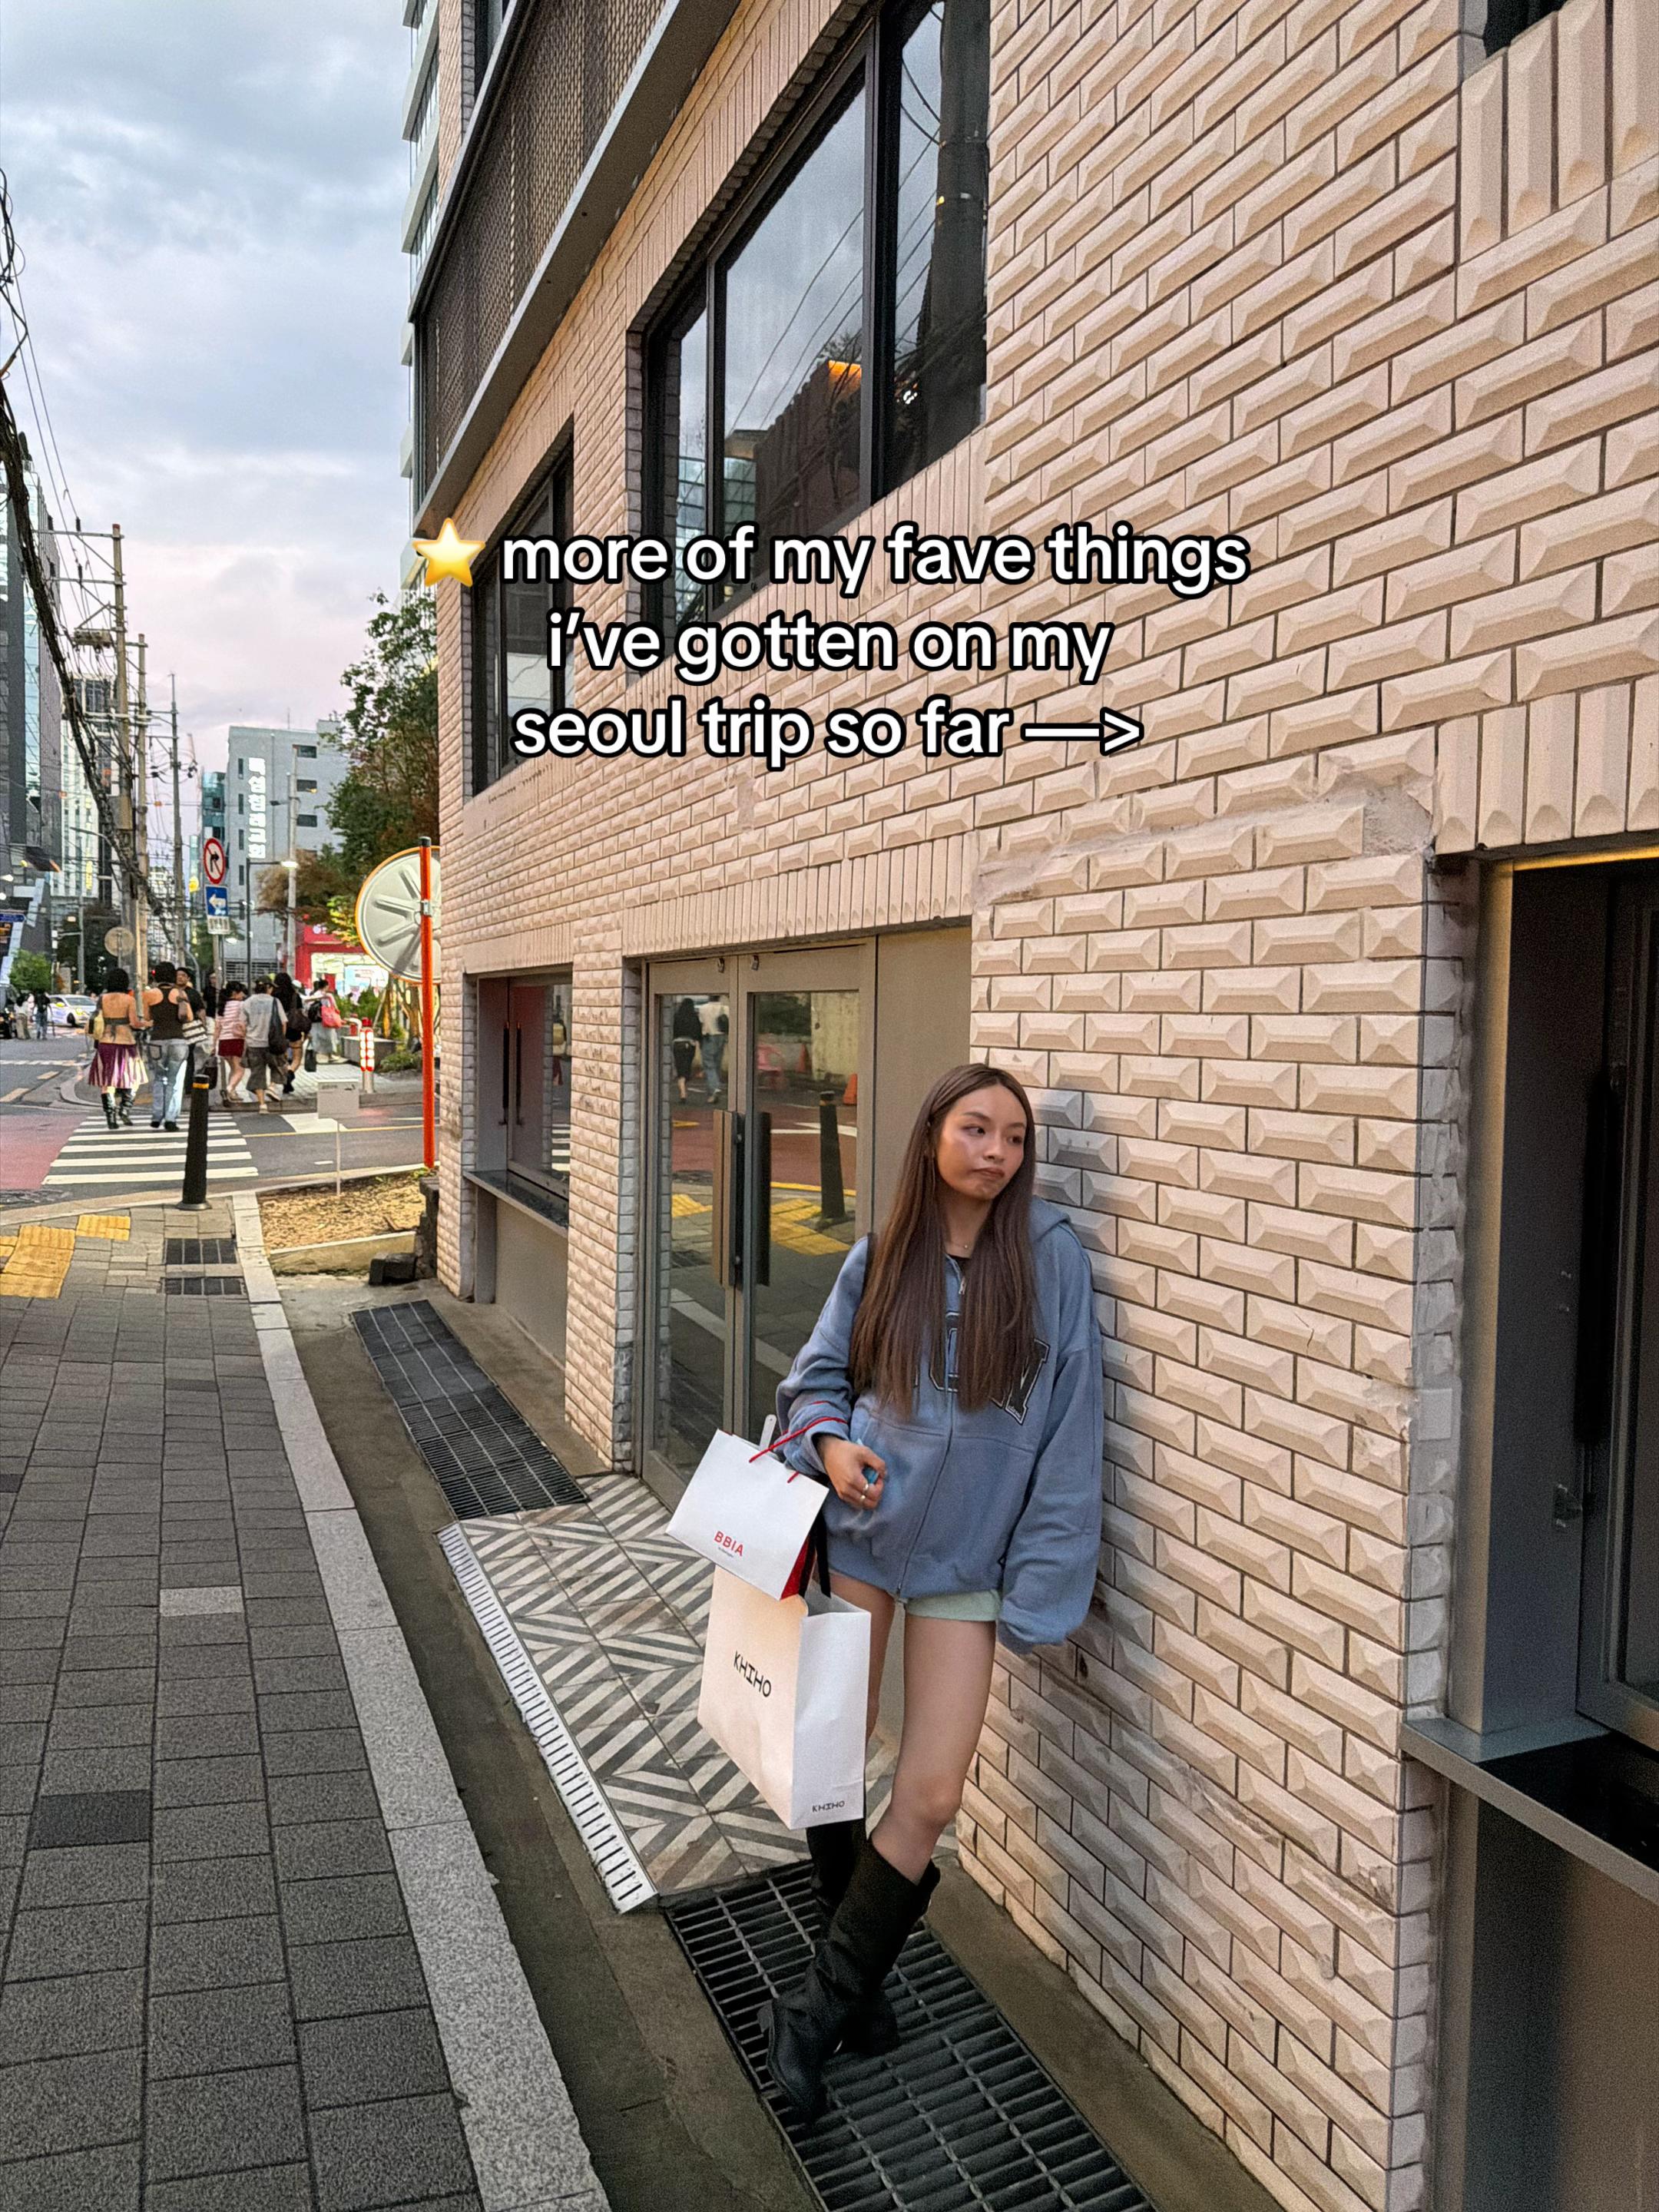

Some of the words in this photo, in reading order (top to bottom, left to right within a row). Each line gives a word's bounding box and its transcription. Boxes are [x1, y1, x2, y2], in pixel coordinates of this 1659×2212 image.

[714, 1531, 743, 1557] BBIA
[733, 1650, 772, 1697] KHIHO
[812, 1800, 846, 1813] KHIHO
